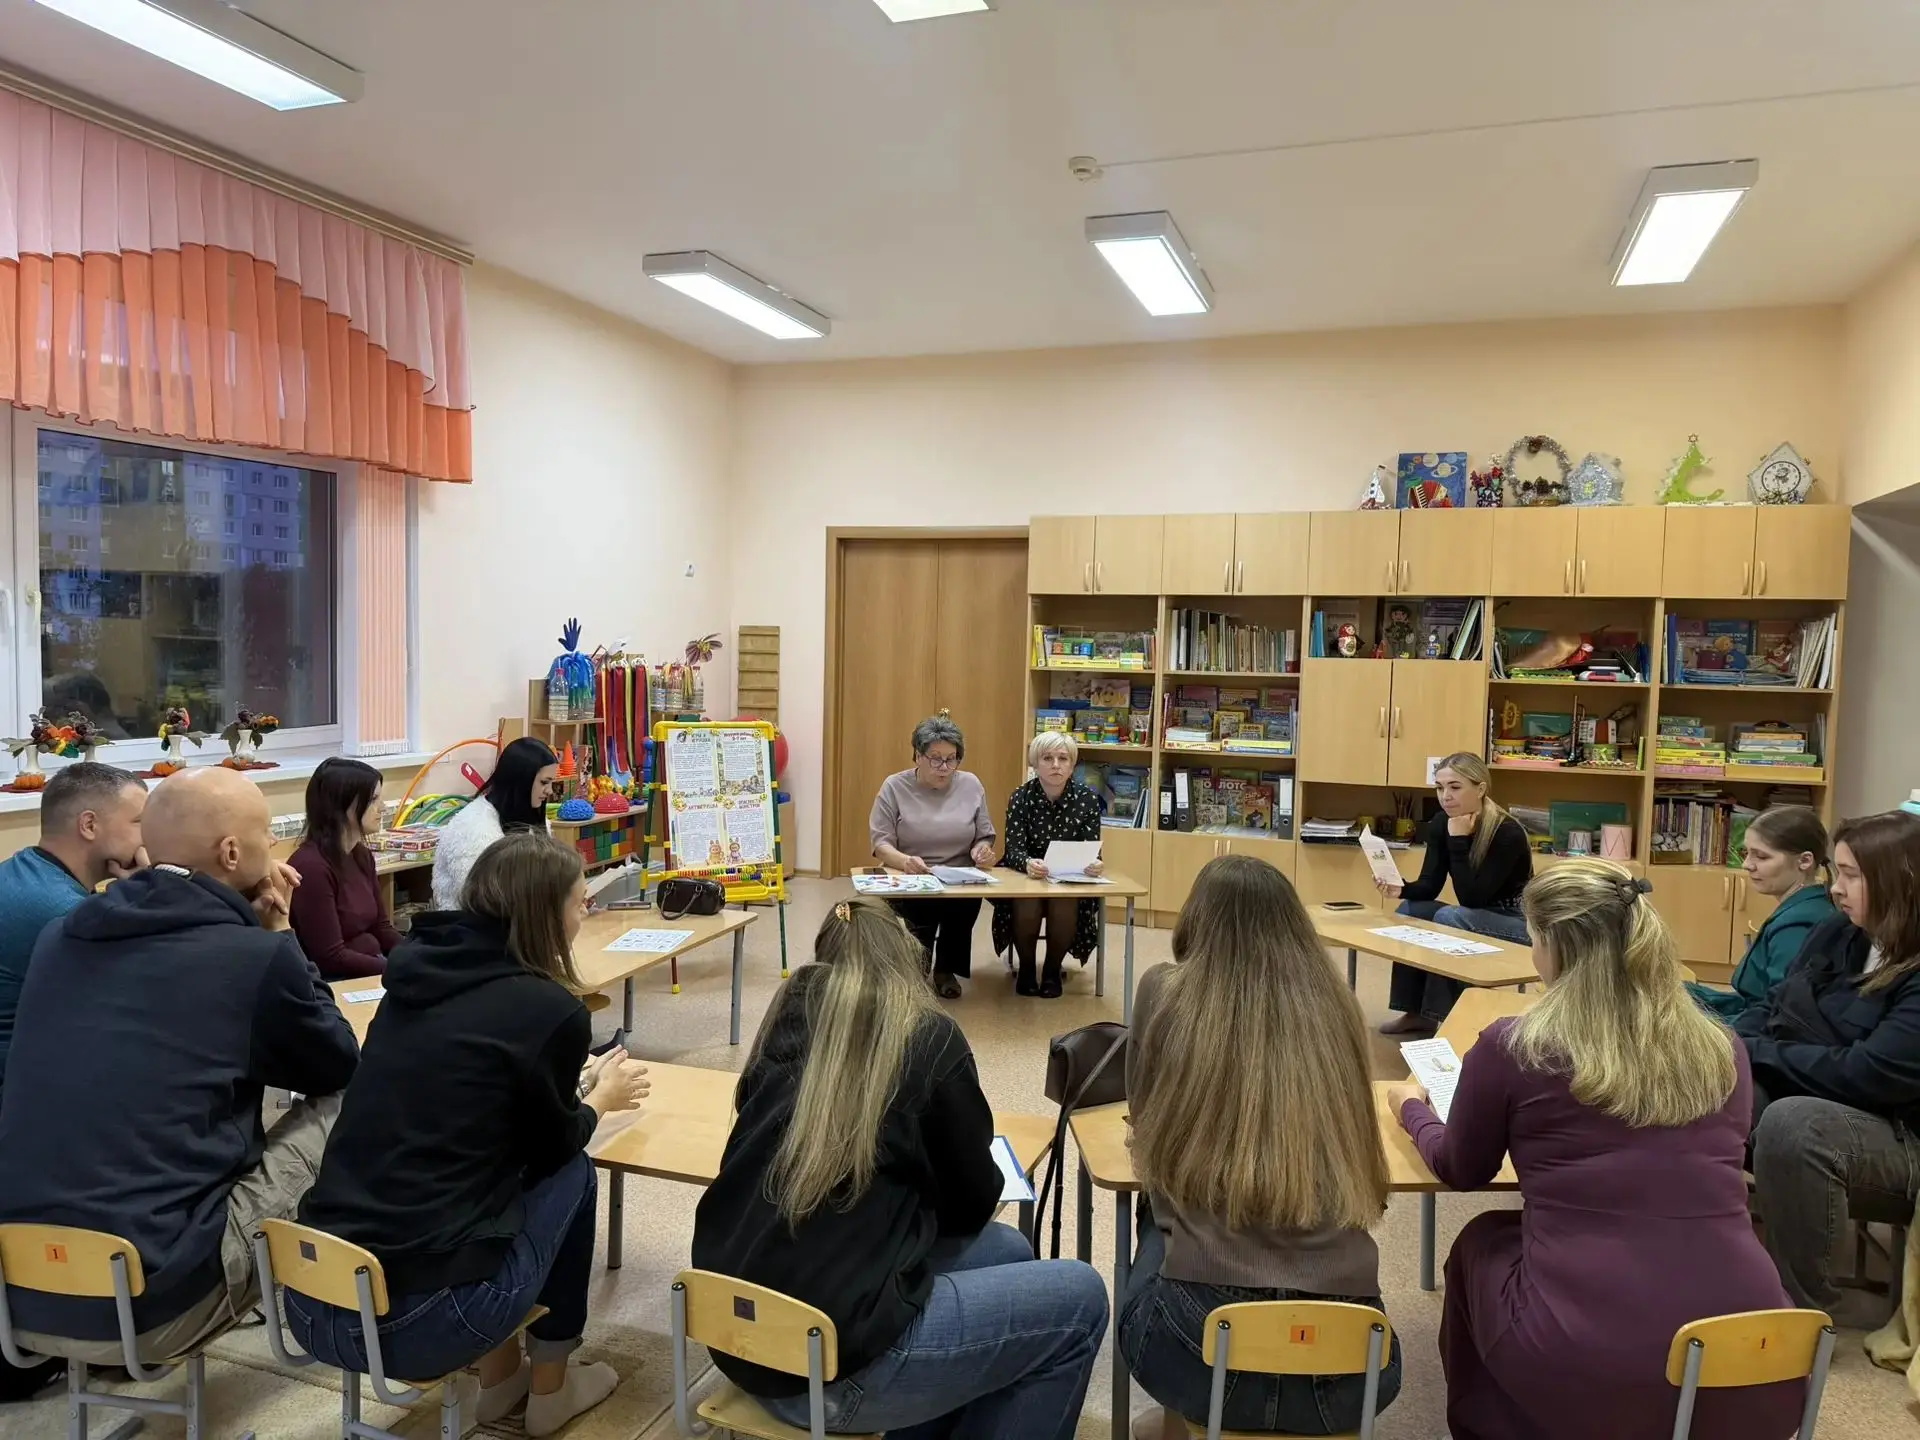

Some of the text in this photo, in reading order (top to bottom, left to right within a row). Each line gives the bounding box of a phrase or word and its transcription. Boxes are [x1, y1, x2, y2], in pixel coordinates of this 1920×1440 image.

[52, 1247, 59, 1260] 1
[1300, 1329, 1305, 1341] 1
[1760, 1337, 1766, 1350] 1
